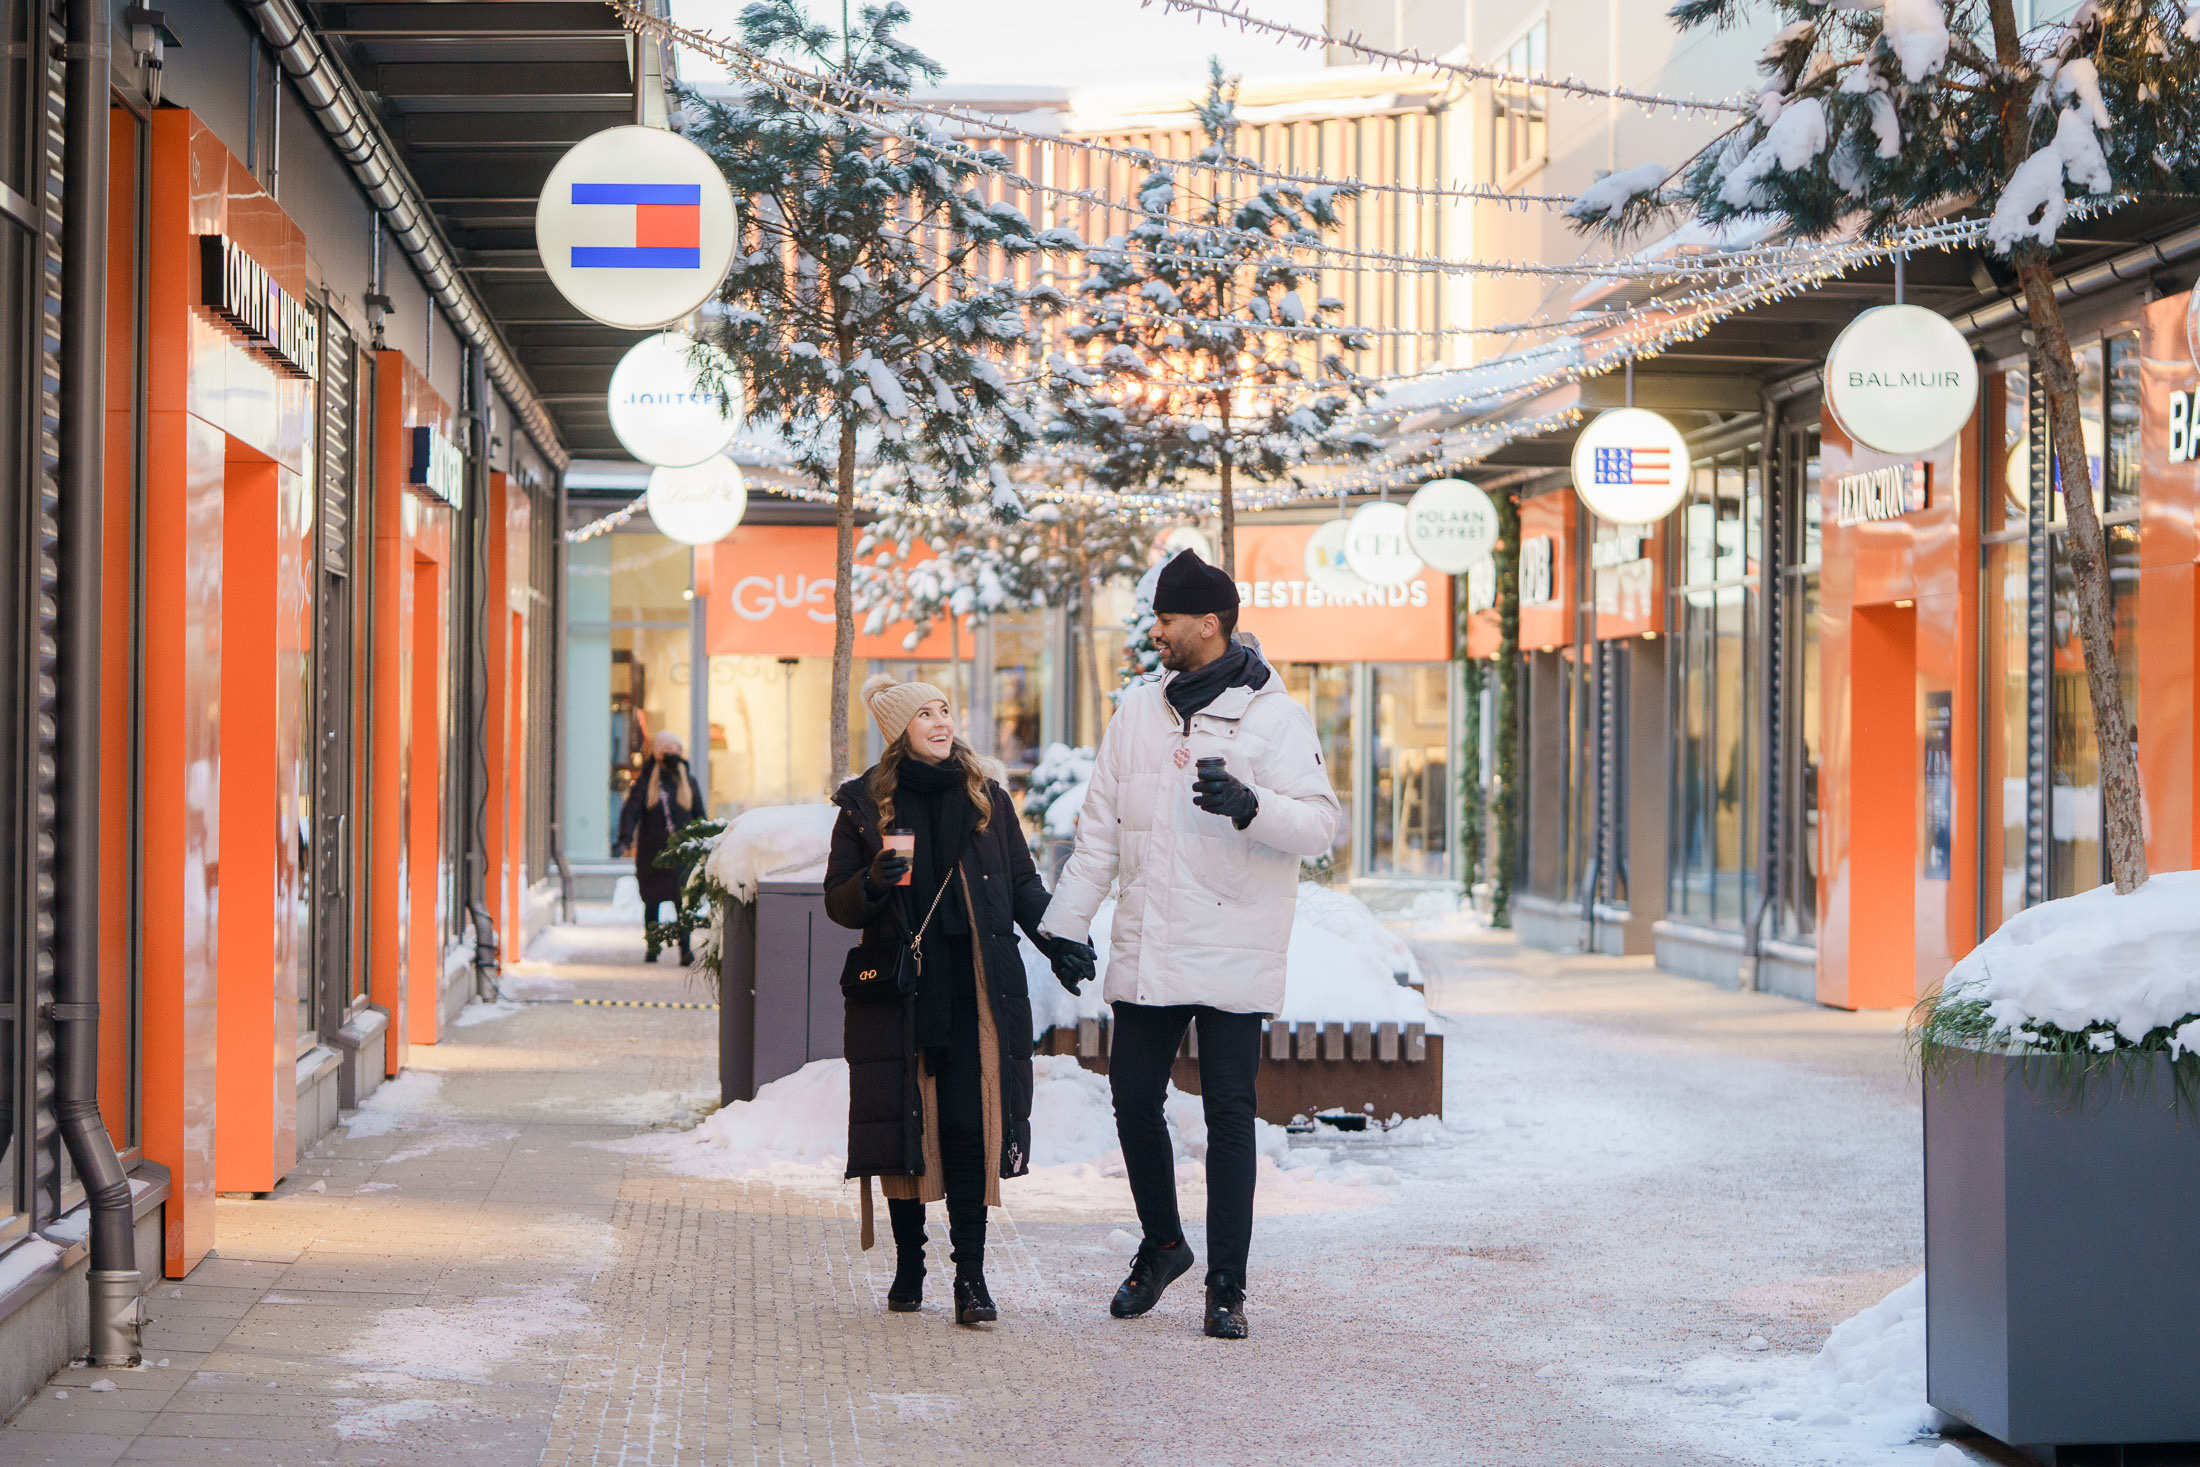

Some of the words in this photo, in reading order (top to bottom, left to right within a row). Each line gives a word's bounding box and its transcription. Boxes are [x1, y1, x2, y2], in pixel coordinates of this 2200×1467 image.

[221, 233, 269, 339] TOMMY
[1849, 371, 1960, 388] BALMUIR
[624, 391, 729, 405] JOUTSE
[1597, 448, 1630, 460] LEX
[1598, 460, 1630, 471] ING
[1596, 471, 1630, 483] TON
[1837, 463, 1905, 528] LEXINGTON
[1416, 511, 1484, 522] POLARN
